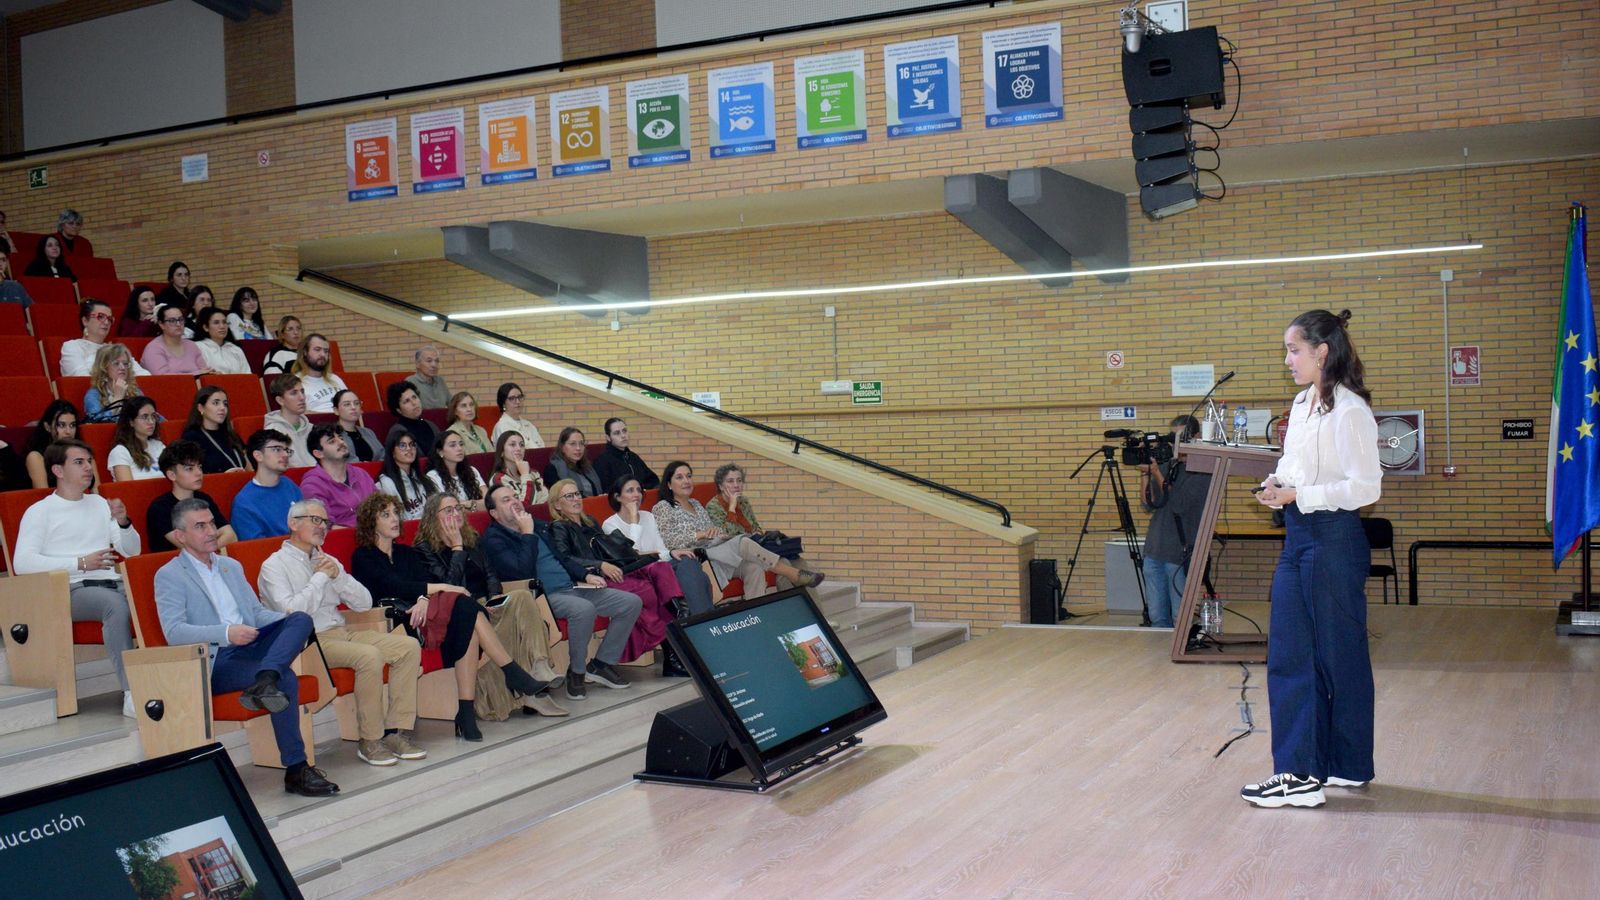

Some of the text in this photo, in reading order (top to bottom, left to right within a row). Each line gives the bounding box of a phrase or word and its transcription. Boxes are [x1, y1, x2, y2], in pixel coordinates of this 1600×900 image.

[997, 54, 1008, 68] 17
[898, 67, 910, 80] 16
[807, 79, 818, 92] 15
[720, 91, 730, 103] 14
[638, 102, 648, 114] 13
[561, 113, 570, 125] 12
[490, 124, 497, 135] 11
[421, 133, 429, 144] 10
[356, 143, 361, 154] 9
[859, 382, 875, 390] SALIDA
[853, 389, 881, 397] EMERGENCIA
[709, 614, 762, 637] Mi educación
